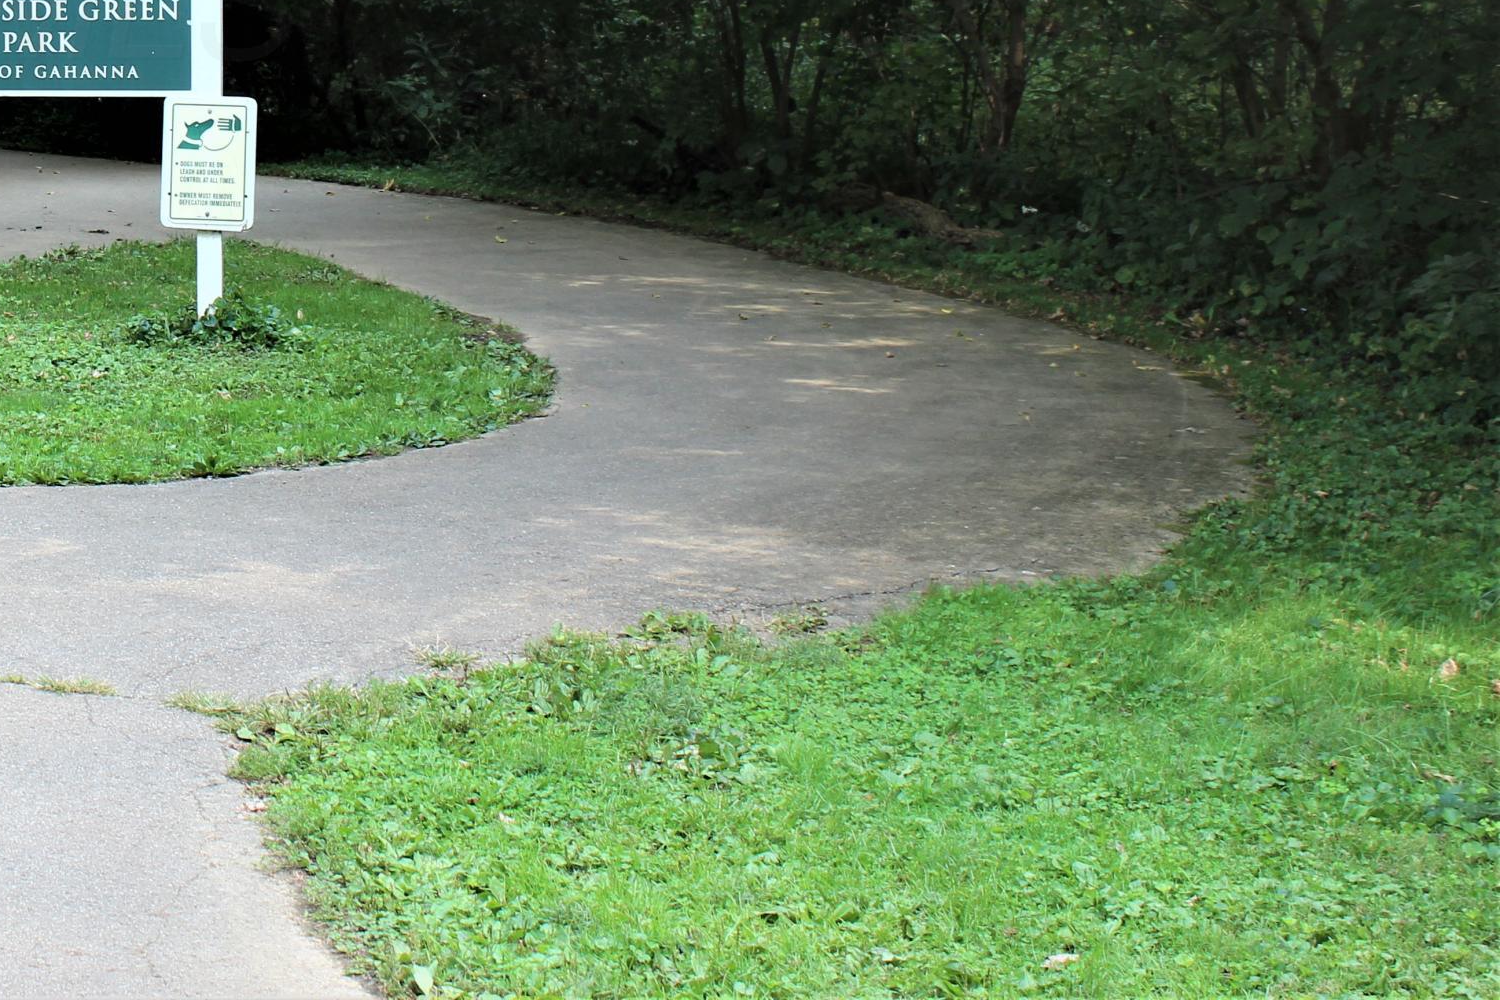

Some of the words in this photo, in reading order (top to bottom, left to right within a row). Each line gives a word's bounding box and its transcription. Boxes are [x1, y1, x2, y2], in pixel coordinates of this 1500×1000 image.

[78, 0, 180, 21] GREEN
[2, 32, 79, 53] PARK
[34, 65, 139, 79] GAHANNA
